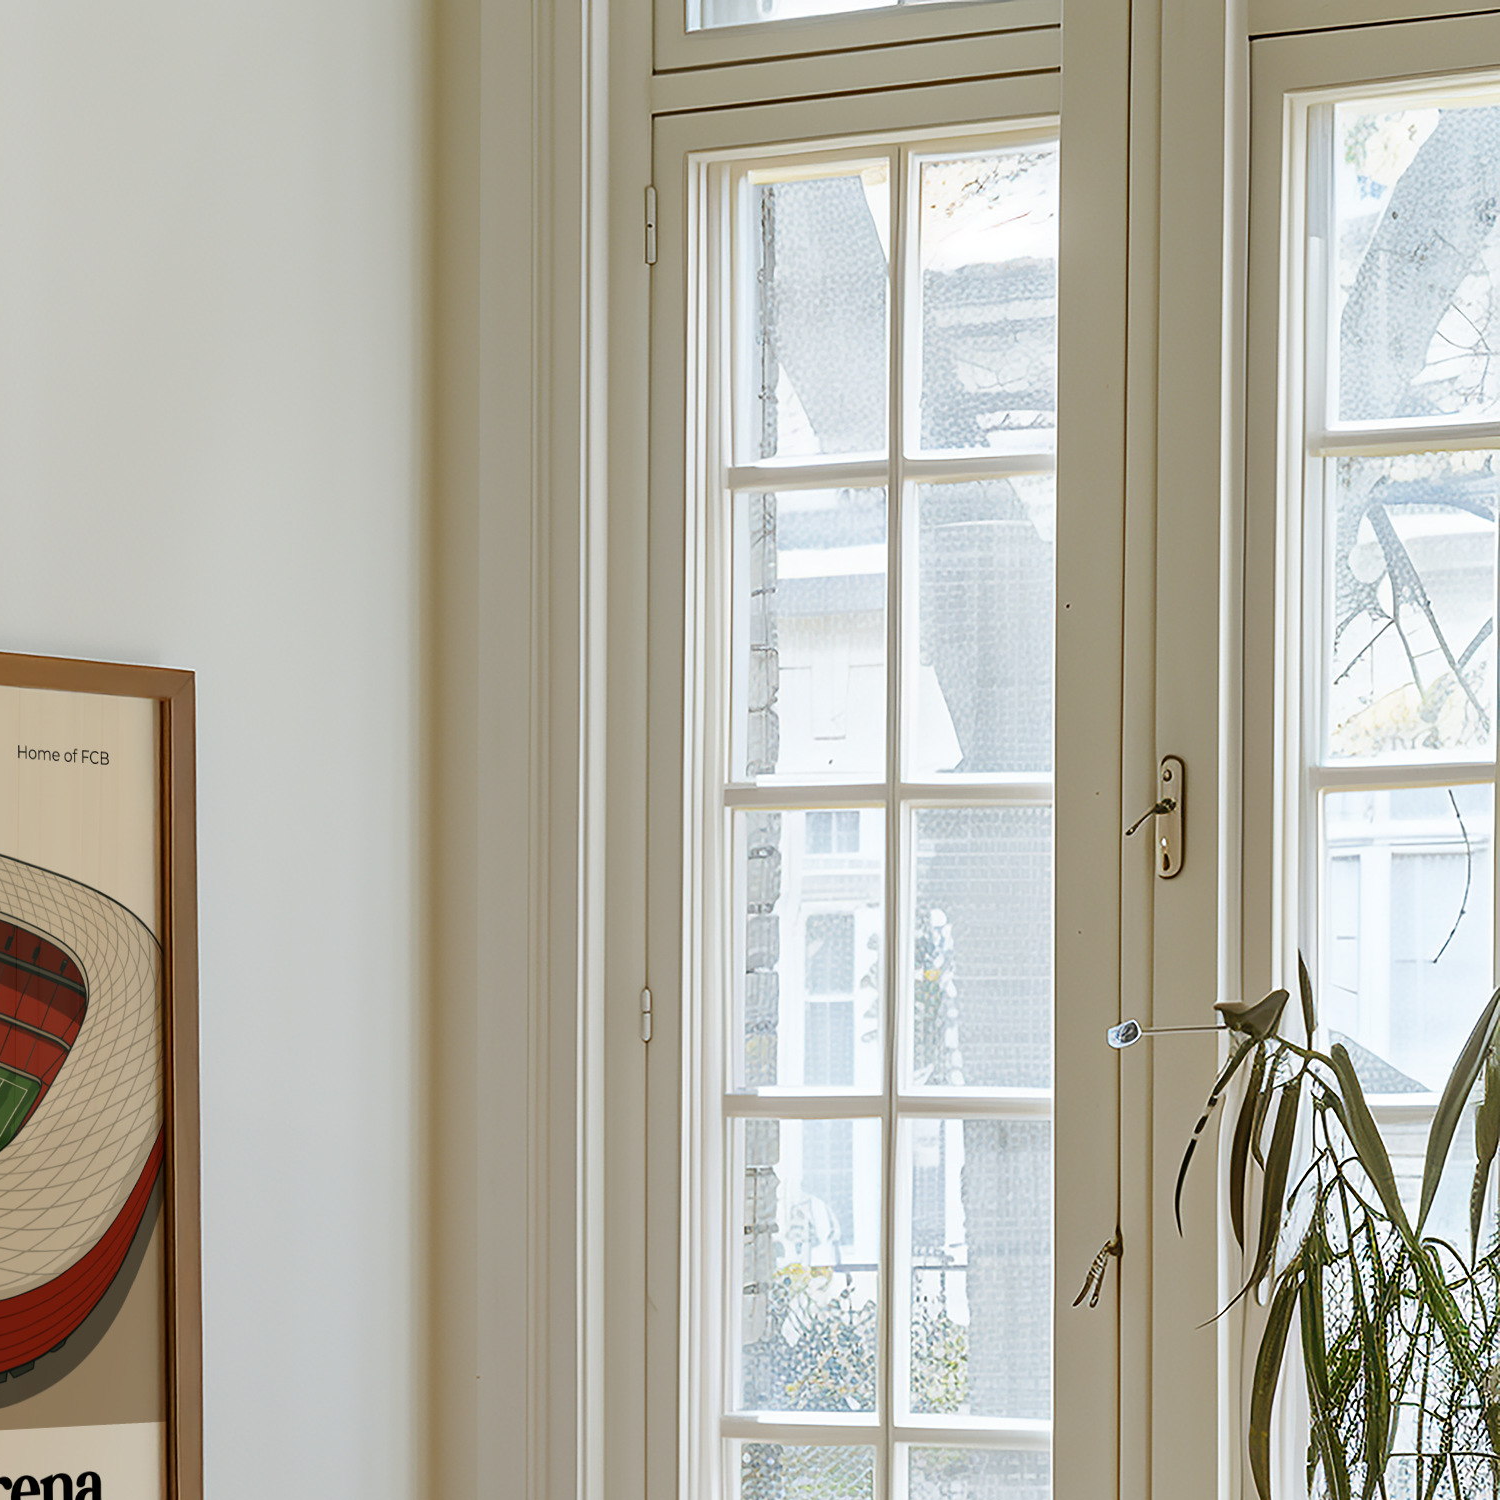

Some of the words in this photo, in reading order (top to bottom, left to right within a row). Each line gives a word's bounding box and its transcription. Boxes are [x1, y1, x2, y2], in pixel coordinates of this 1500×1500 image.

[17, 744, 61, 762] Home
[63, 748, 78, 764] of
[81, 749, 110, 766] FCB
